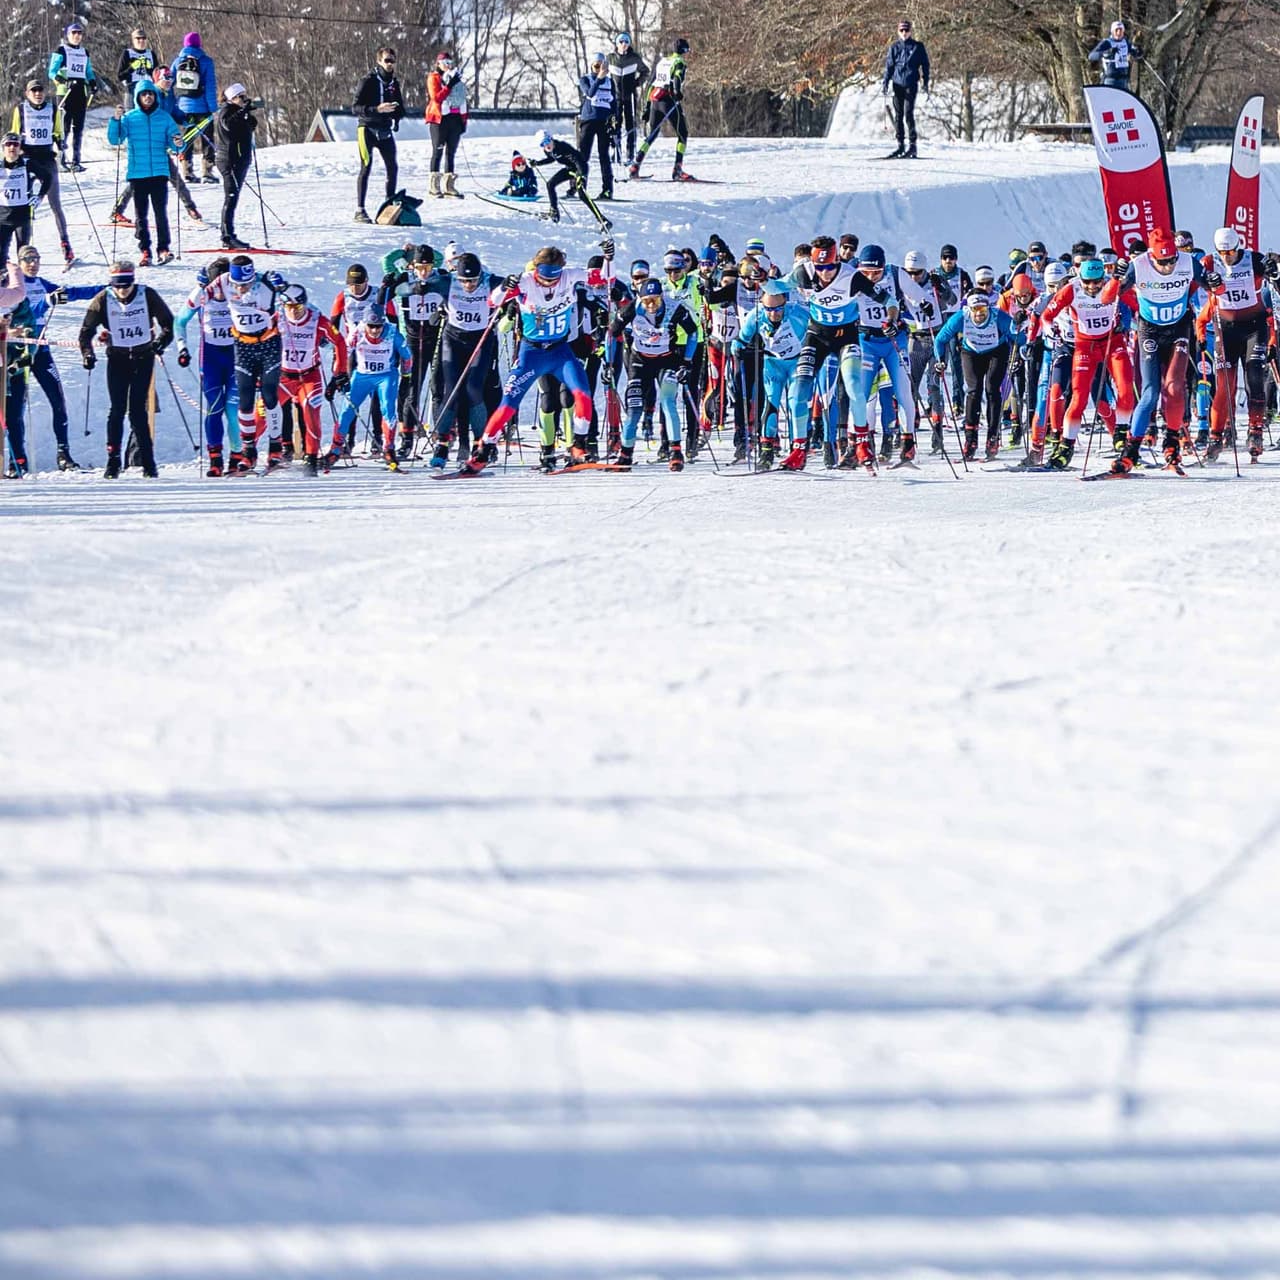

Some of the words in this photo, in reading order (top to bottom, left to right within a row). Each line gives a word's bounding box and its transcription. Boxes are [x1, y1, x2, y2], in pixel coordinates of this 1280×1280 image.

[1108, 121, 1134, 131] SAVOIE
[30, 128, 48, 139] 380
[4, 188, 21, 200] 471
[1114, 203, 1142, 255] oie
[1140, 278, 1189, 291] ekosport
[1226, 290, 1249, 302] 154
[416, 302, 437, 314] 218
[865, 306, 887, 319] 131
[1150, 303, 1183, 322] 108
[237, 313, 264, 326] 272
[456, 311, 481, 324] 304
[1086, 317, 1109, 329] 155
[119, 326, 143, 339] 144
[284, 349, 307, 362] 137
[364, 361, 384, 371] 168
